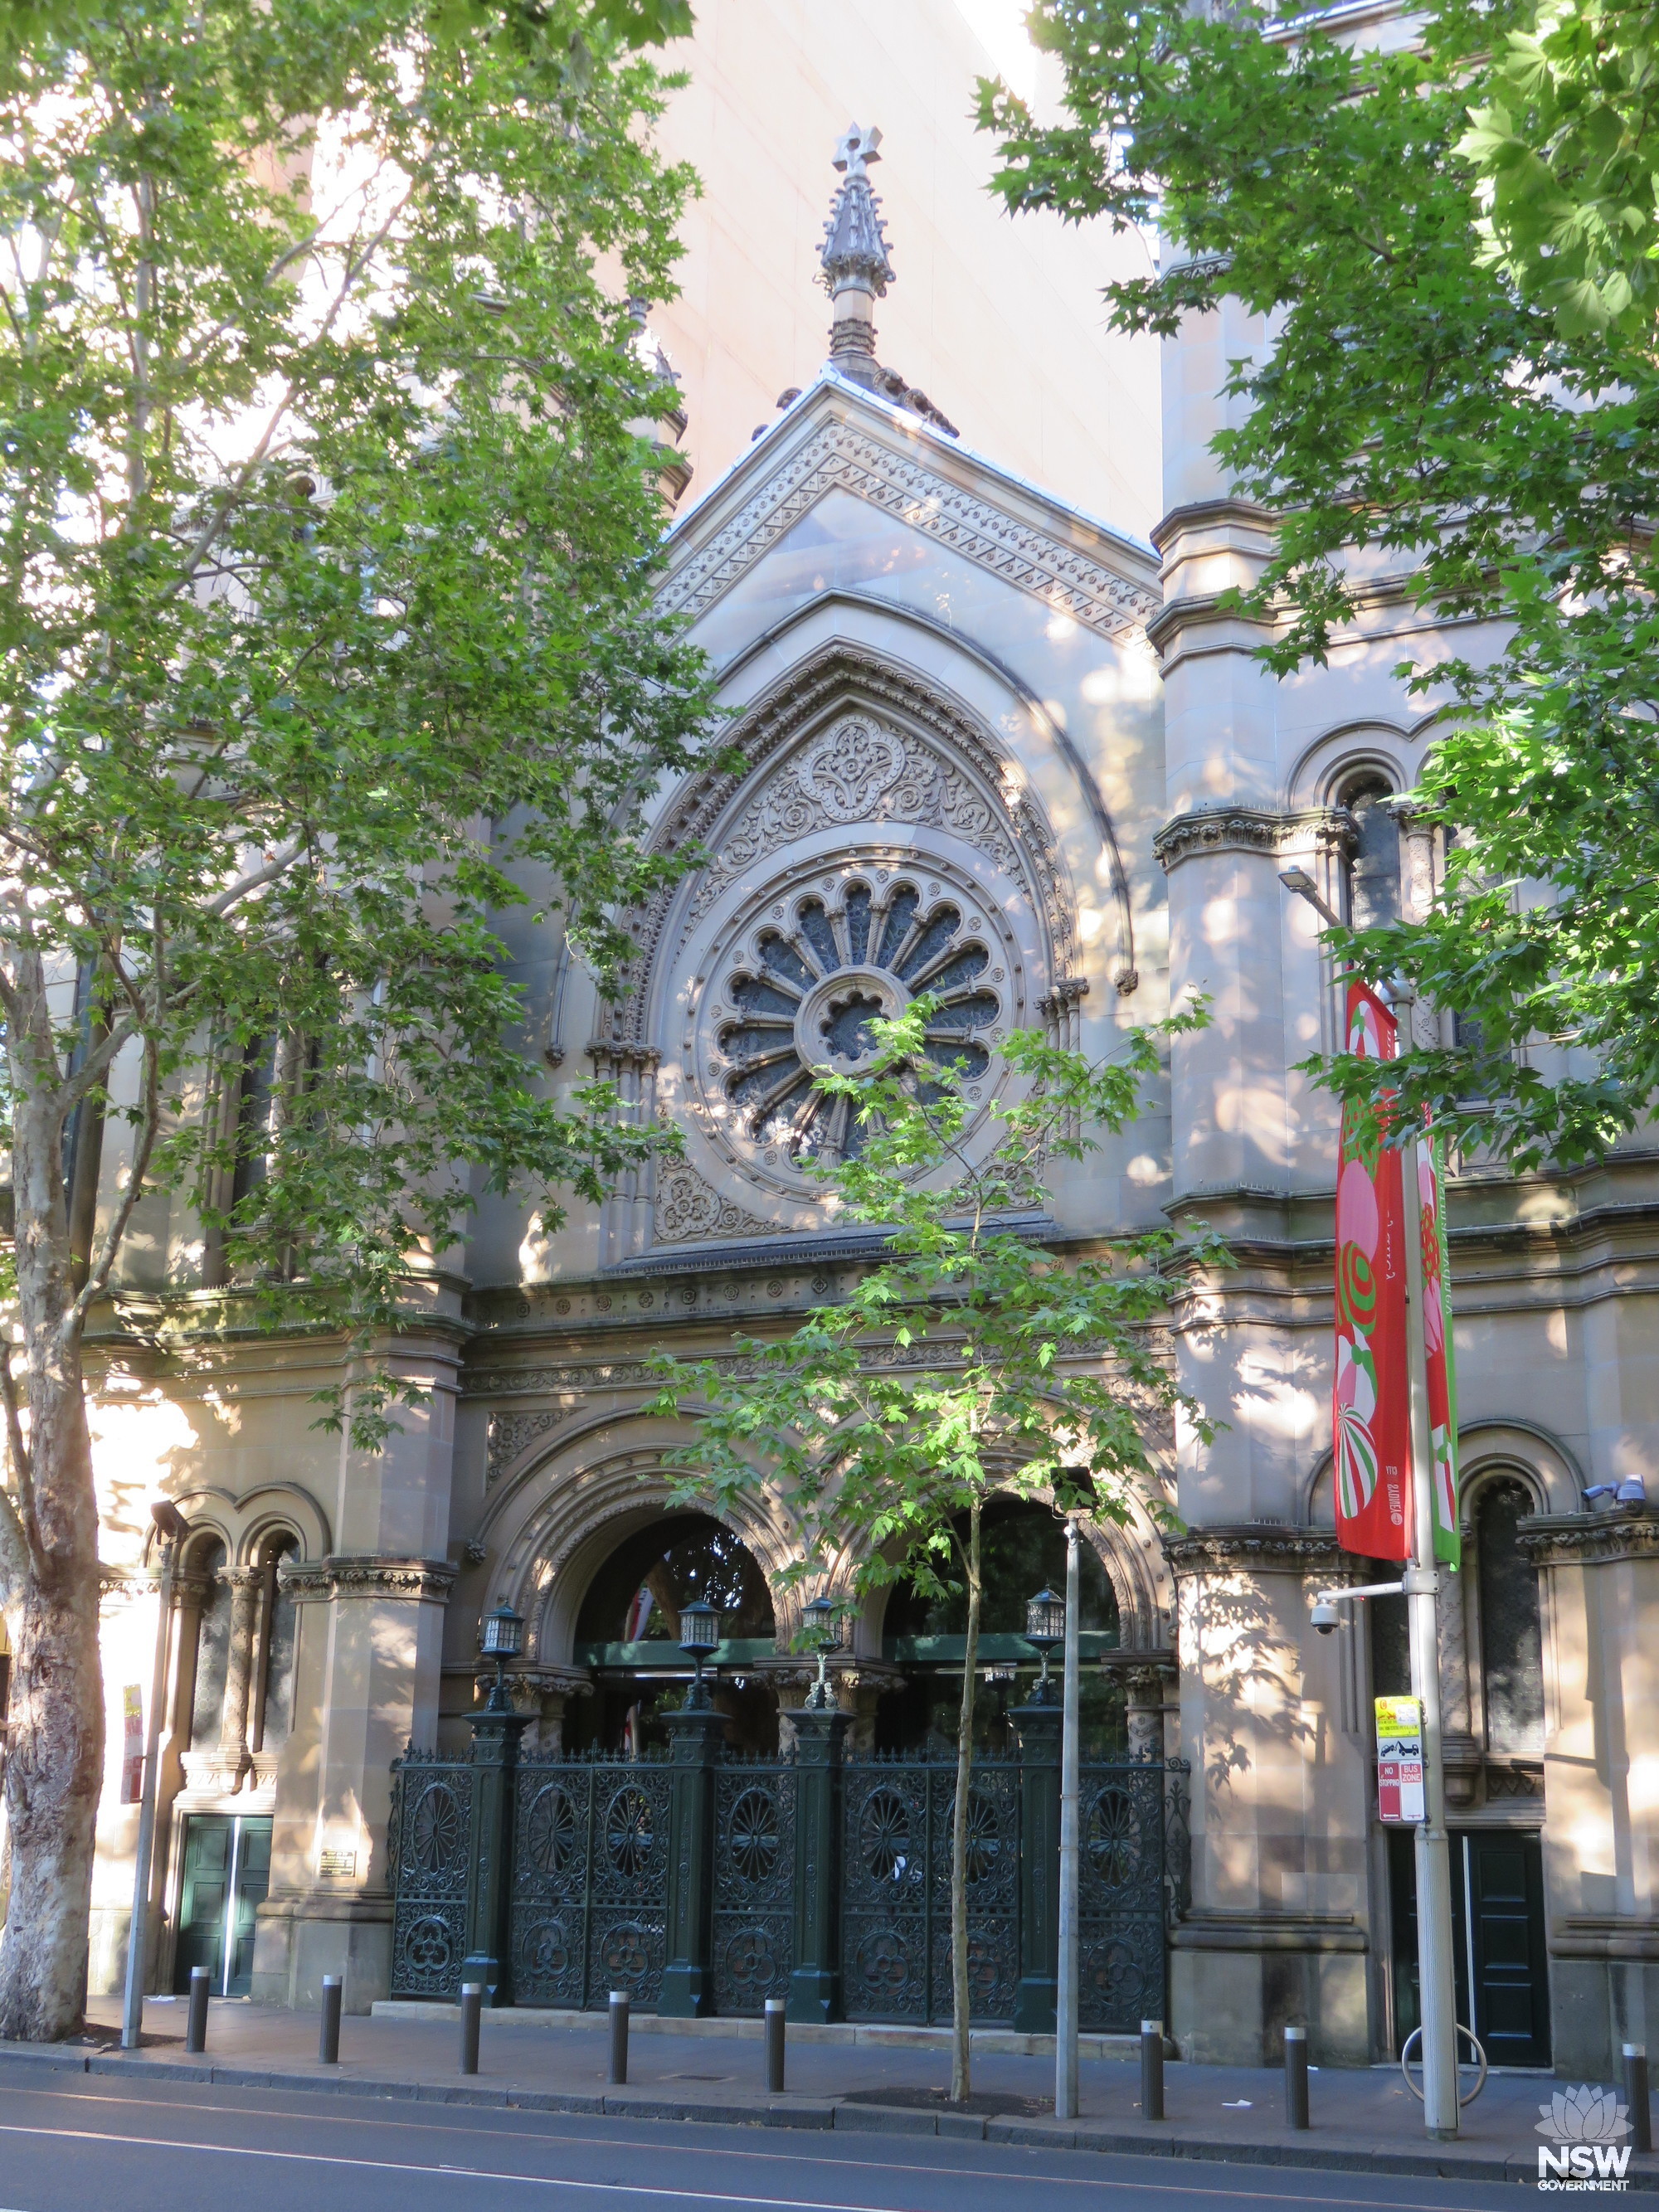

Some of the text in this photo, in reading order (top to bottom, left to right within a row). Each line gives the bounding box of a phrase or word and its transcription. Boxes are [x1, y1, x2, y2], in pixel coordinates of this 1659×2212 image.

[1384, 1767, 1394, 1775] NO
[1404, 1765, 1418, 1773] BUS
[1402, 1773, 1421, 1782] ZONE
[1379, 1778, 1400, 1787] STOPPING
